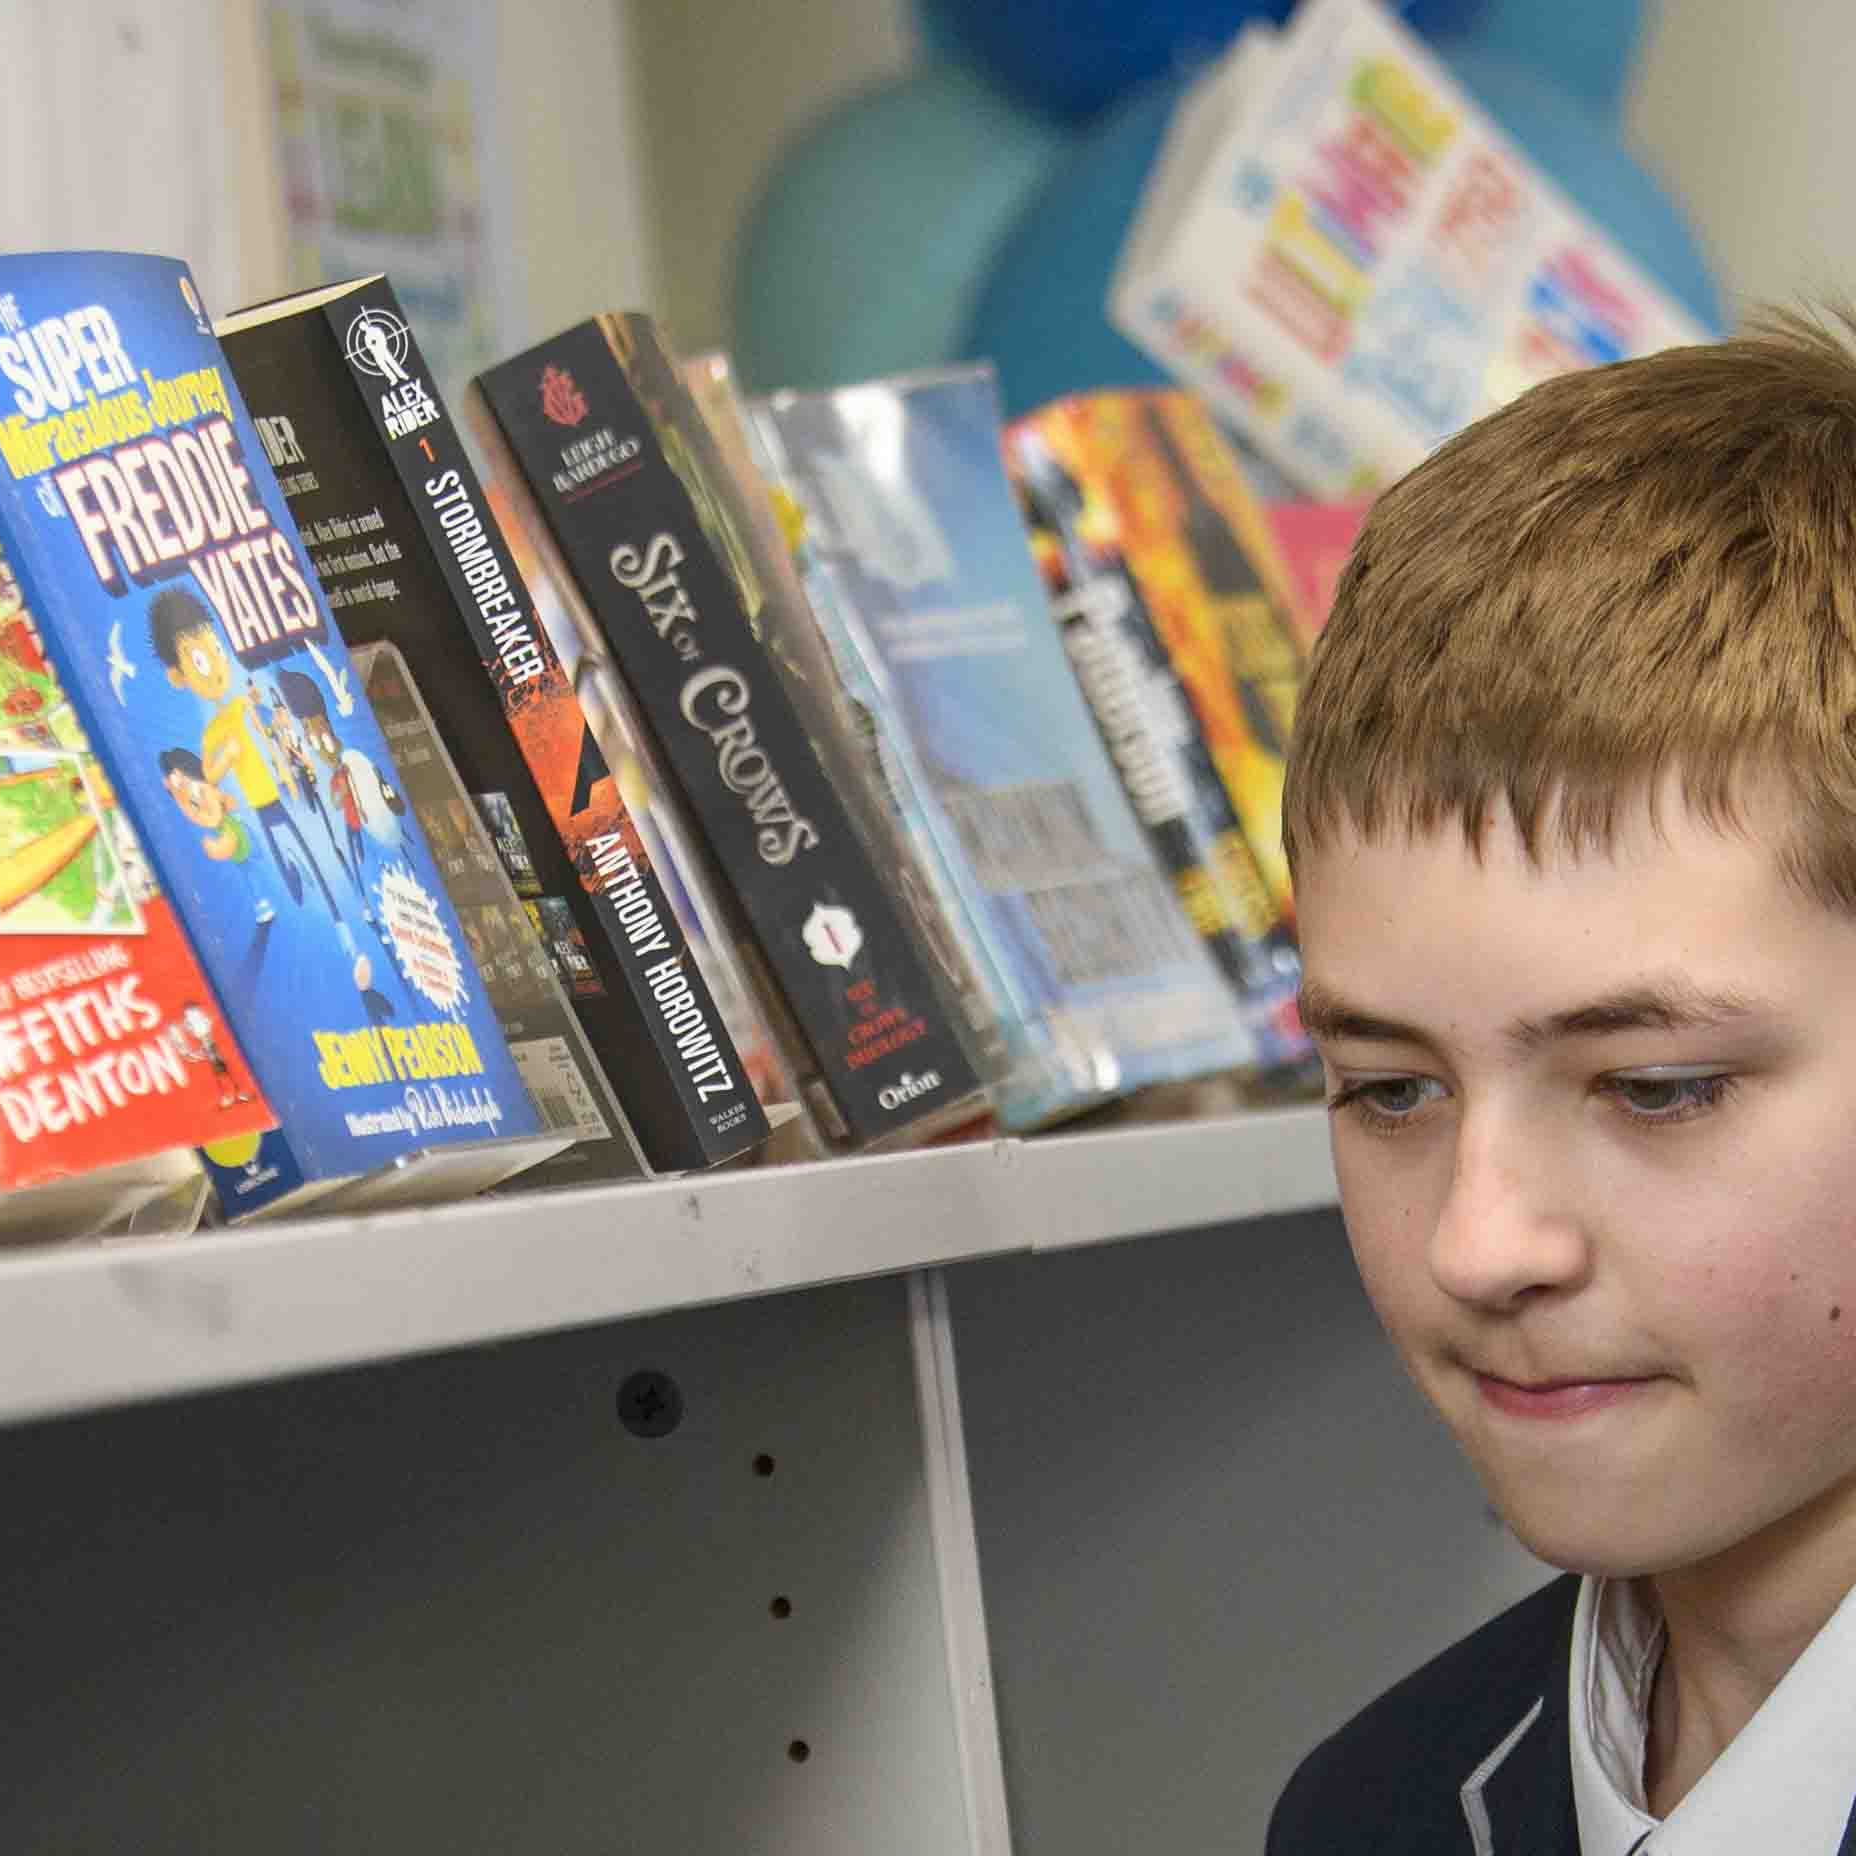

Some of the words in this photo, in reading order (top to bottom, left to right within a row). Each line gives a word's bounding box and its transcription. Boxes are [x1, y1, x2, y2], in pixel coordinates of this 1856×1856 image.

[140, 366, 234, 428] Journey
[379, 379, 430, 422] ALEX
[384, 399, 441, 441] RIDER
[419, 436, 435, 464] 1
[551, 437, 643, 496] BARDUGO
[55, 417, 270, 583] FREDDIE
[189, 528, 322, 655] YATES
[424, 467, 545, 687] STORMBREAKER
[584, 832, 673, 960] ANTHONY
[644, 956, 735, 1104] HOROWITZ
[312, 1026, 393, 1090] JENNY
[381, 1022, 485, 1081] PEARSON
[708, 1103, 747, 1131] WALKER
[878, 1069, 942, 1110] Orion
[715, 1112, 748, 1135] BOOKS
